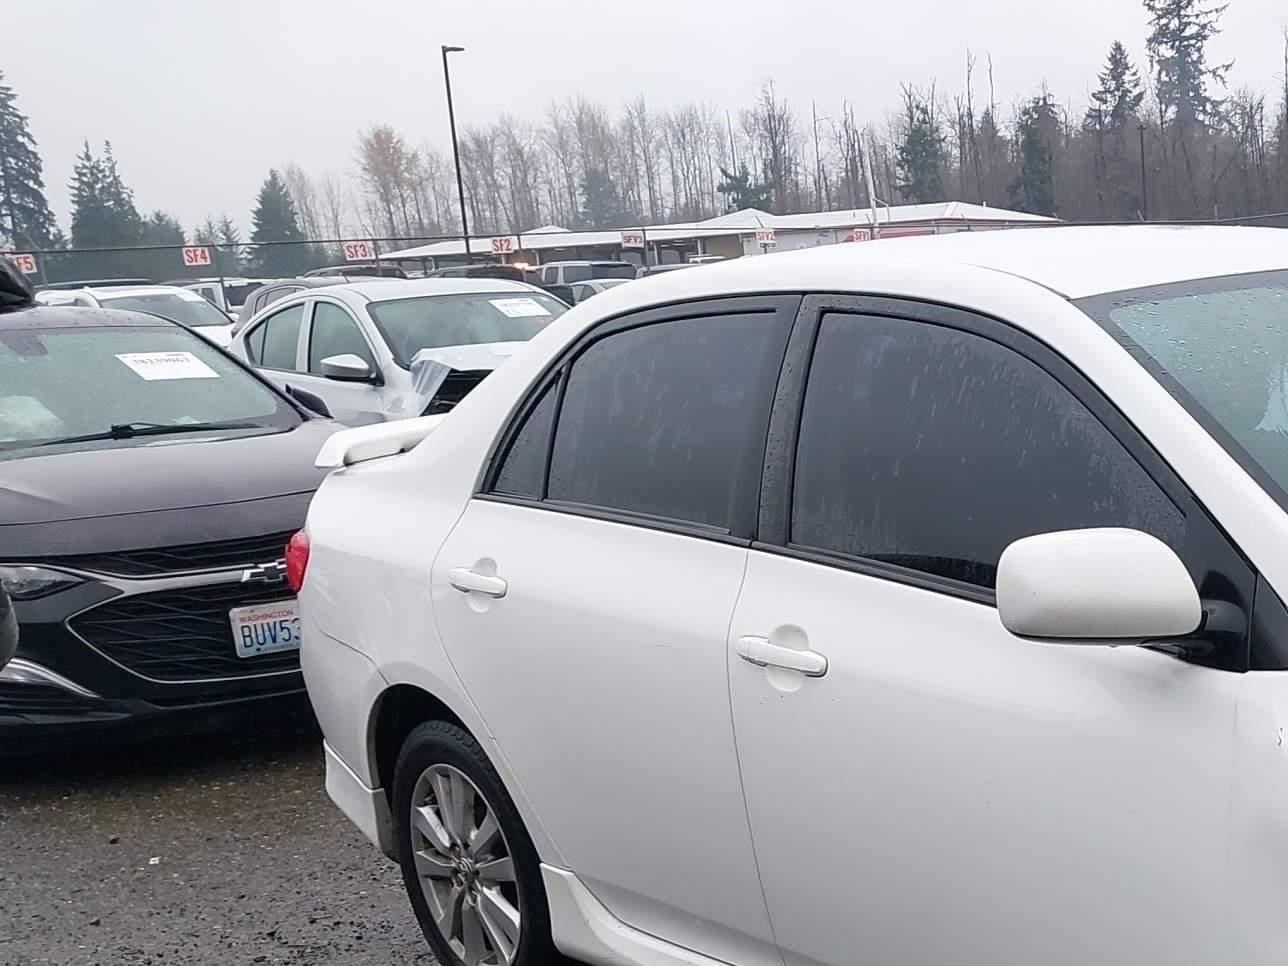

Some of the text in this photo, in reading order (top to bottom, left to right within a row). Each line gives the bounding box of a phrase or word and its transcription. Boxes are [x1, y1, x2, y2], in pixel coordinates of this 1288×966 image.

[345, 244, 369, 259] SF3
[492, 239, 511, 251] SF2
[185, 249, 208, 263] SF4
[239, 609, 294, 622] WASHINGTON
